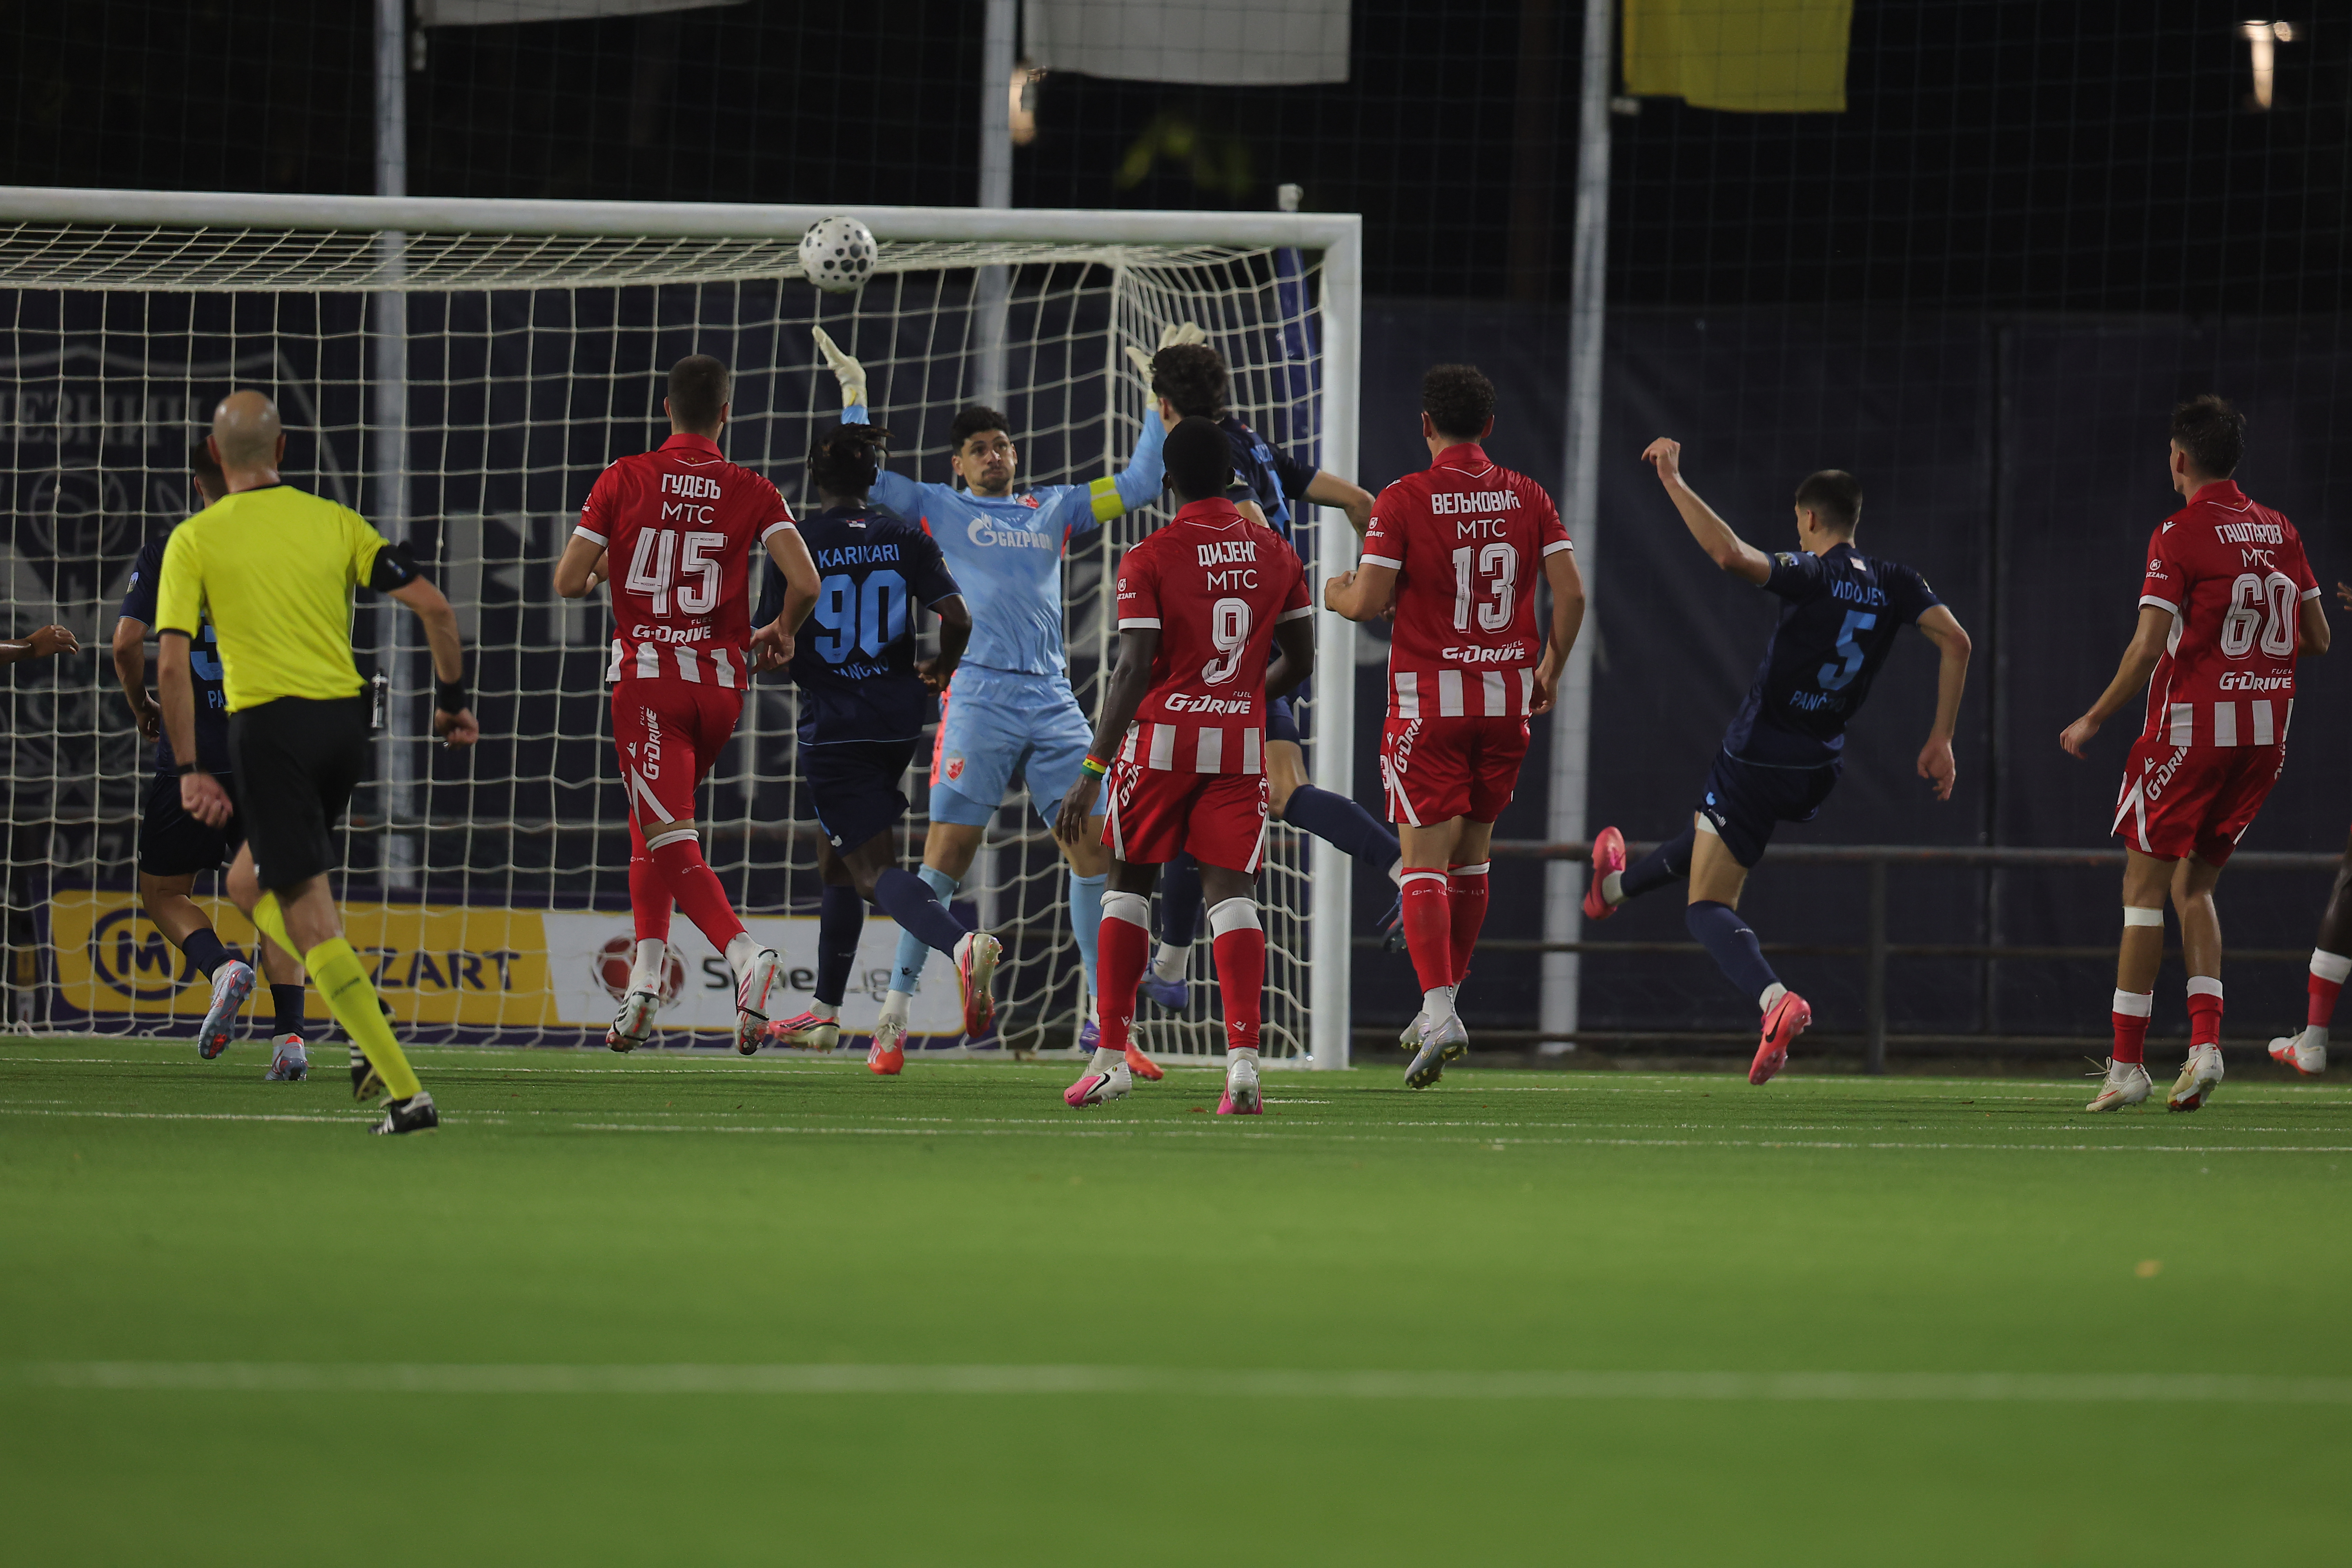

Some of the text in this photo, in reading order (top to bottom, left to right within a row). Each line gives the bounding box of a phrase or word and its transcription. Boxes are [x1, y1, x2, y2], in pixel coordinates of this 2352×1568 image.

[661, 473, 721, 499] ГУДЕЉ
[818, 544, 900, 568] KARIKARI
[1197, 541, 1257, 567] ДИЈЕНГ
[2214, 523, 2283, 544] ГАШТАРОВ
[625, 526, 728, 618] 45
[1452, 542, 1519, 634] 13
[691, 616, 713, 625] FUEL
[814, 569, 906, 664] 90
[1201, 597, 1253, 687] 9
[2220, 572, 2300, 660] 60
[1501, 639, 1523, 649] FUEL
[1817, 609, 1877, 691] 5
